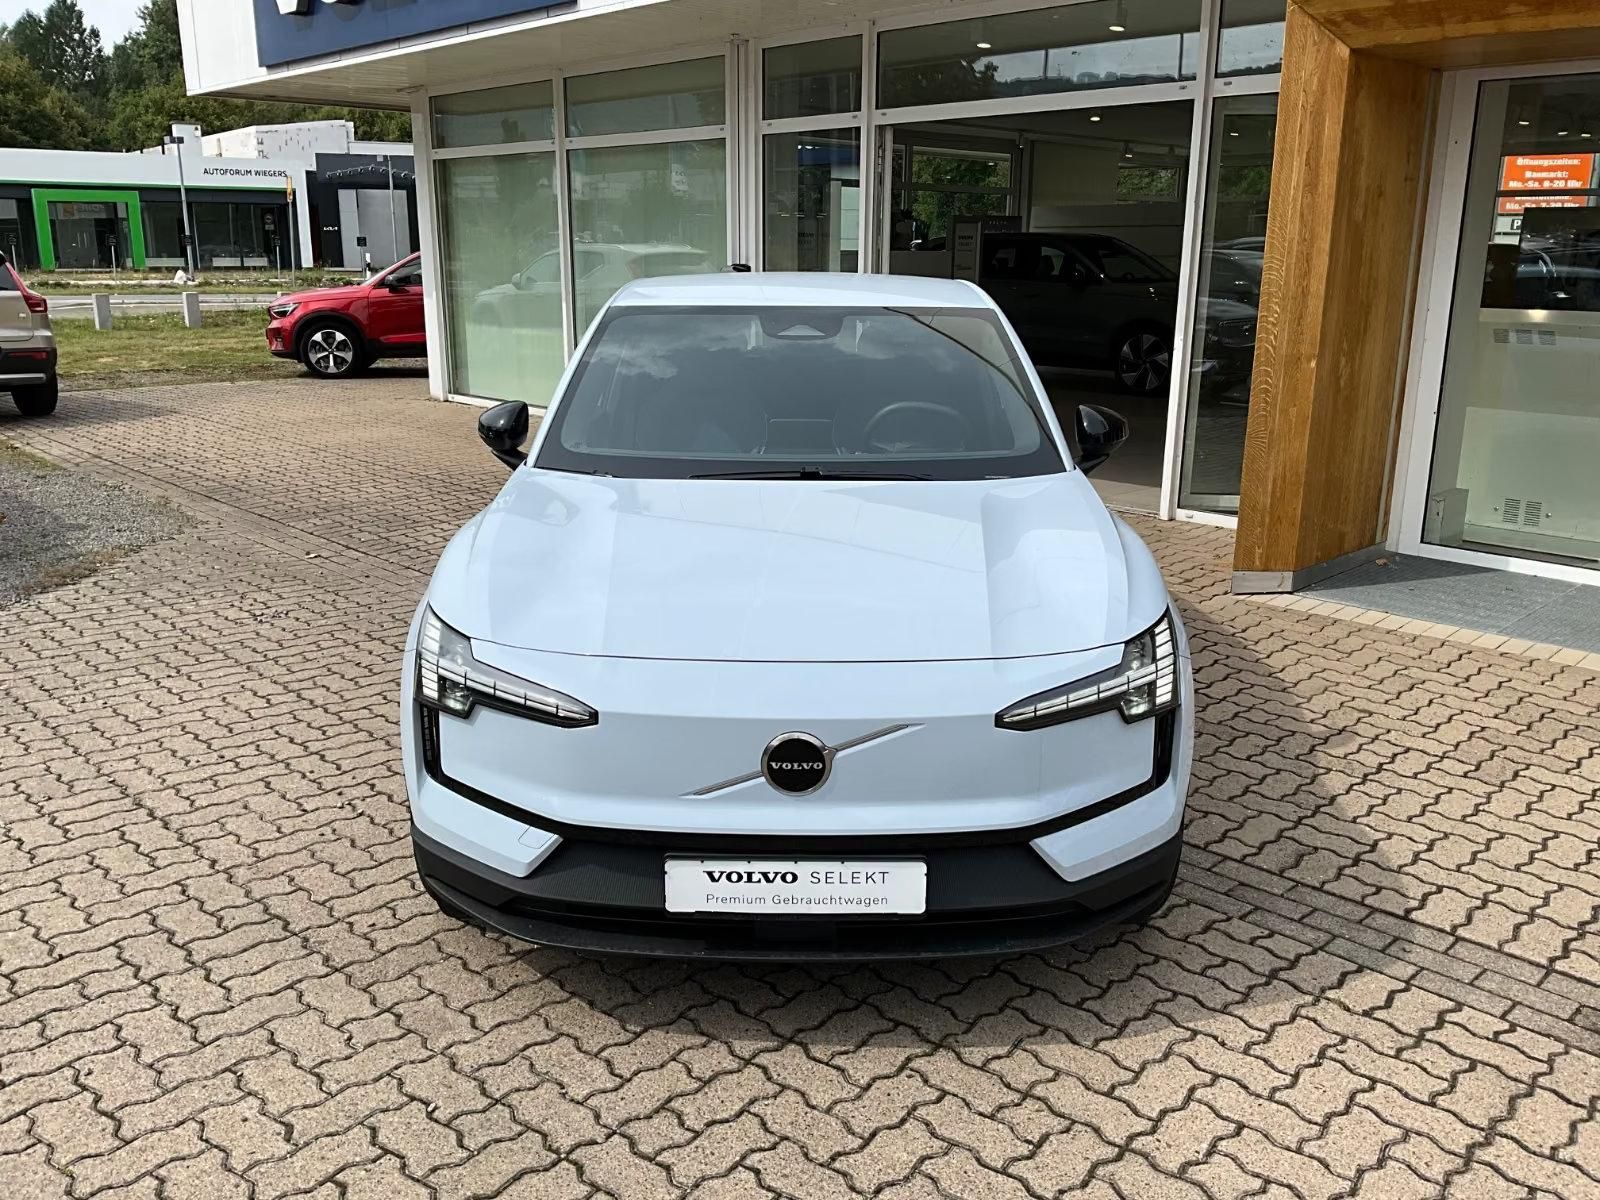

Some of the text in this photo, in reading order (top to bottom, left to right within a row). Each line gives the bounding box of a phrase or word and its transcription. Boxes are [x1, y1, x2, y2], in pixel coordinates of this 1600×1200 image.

[203, 167, 288, 178] AUTOFORUM WIEGERS
[1567, 180, 1583, 188] Uhr
[769, 761, 823, 770] VOLVO
[703, 870, 889, 884] VOLVO SELEKT
[706, 894, 888, 907] Premium Gebrauchtwagen
